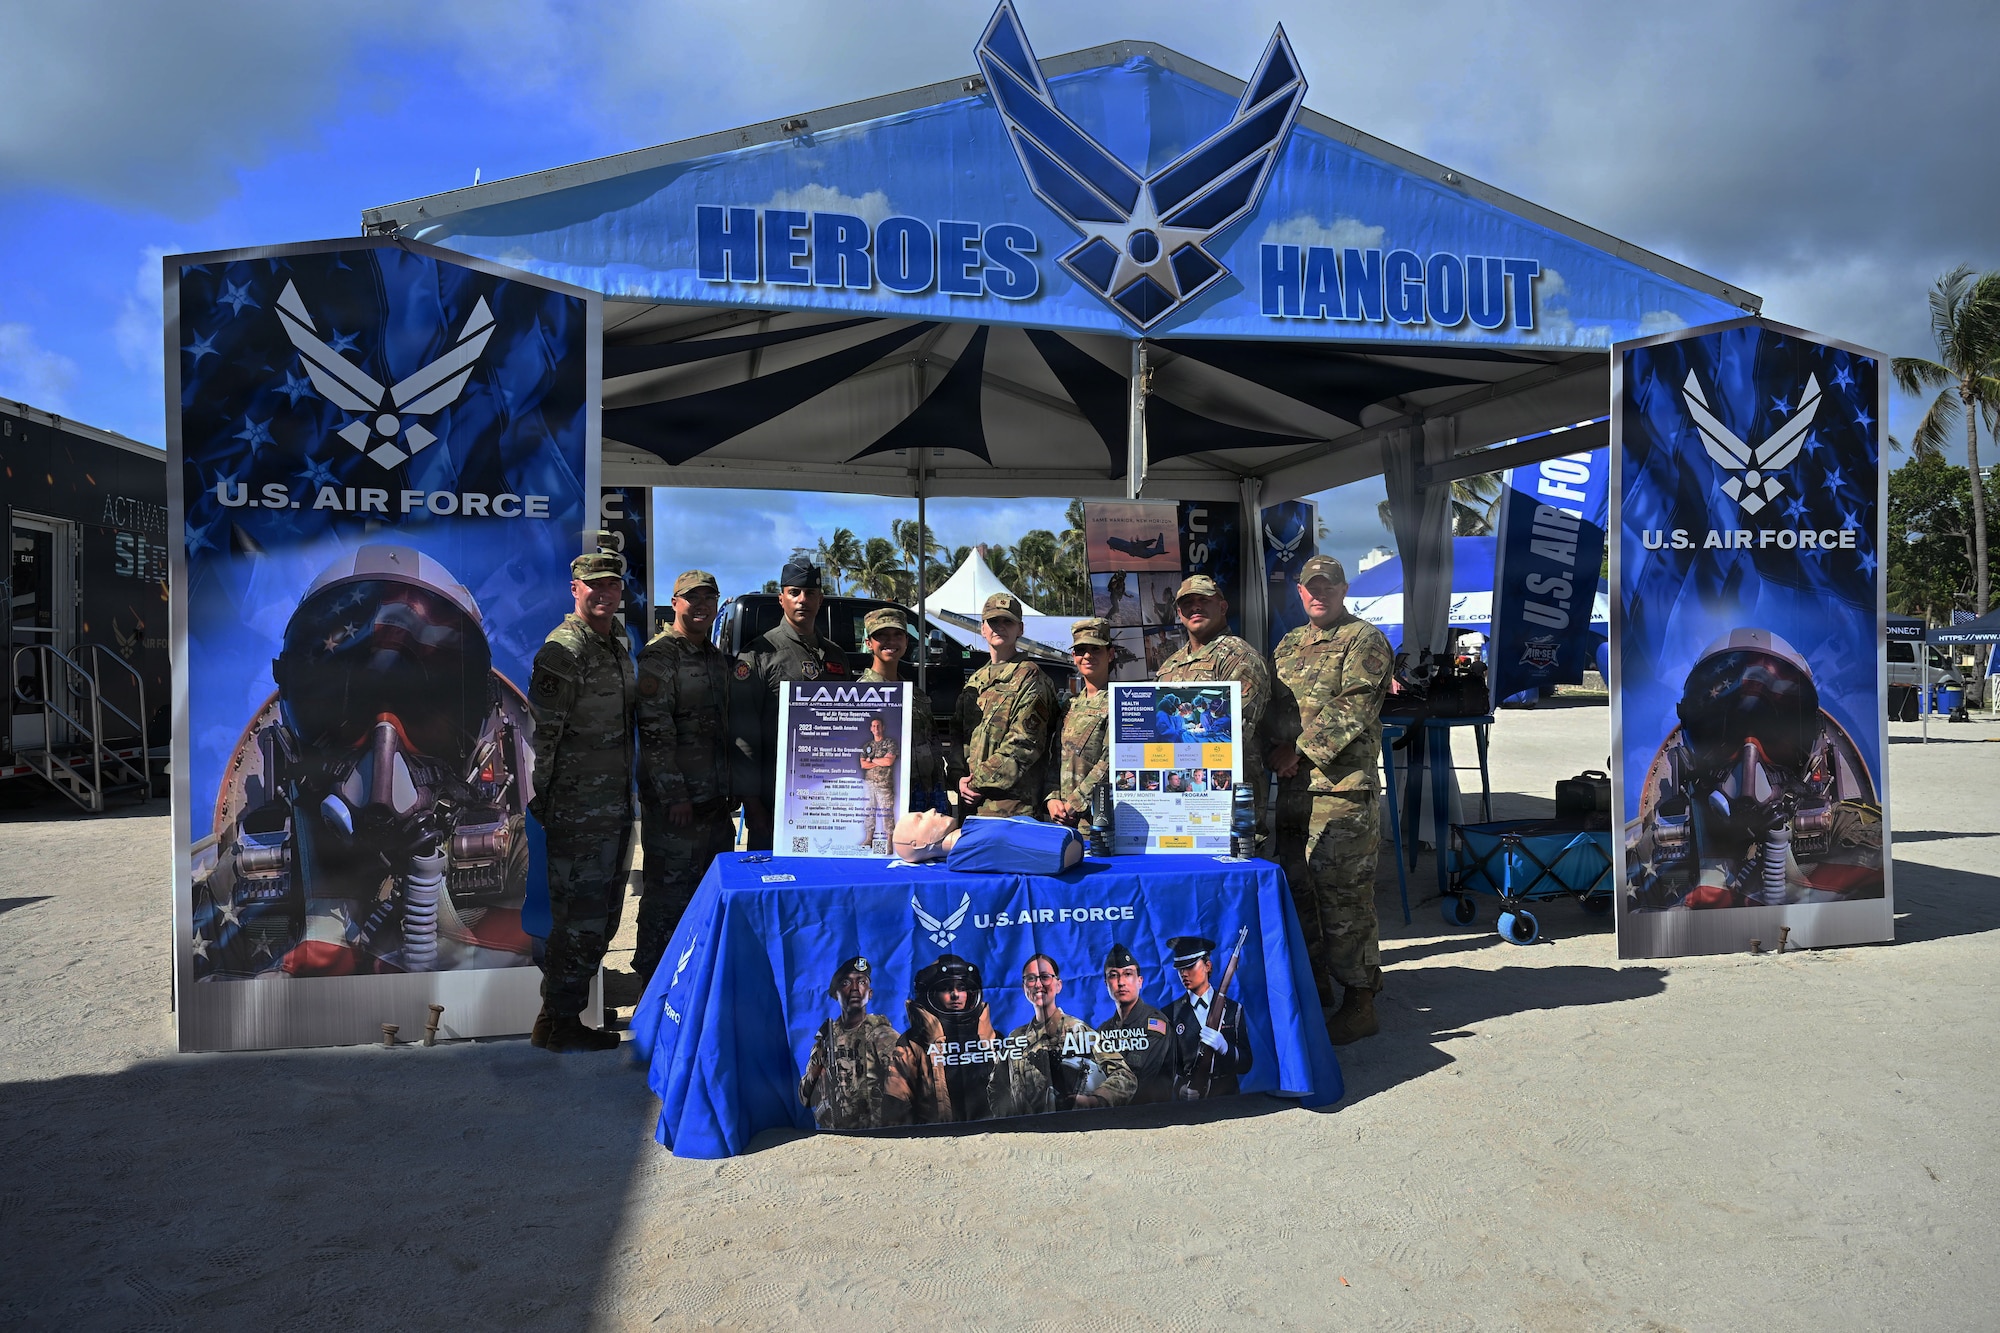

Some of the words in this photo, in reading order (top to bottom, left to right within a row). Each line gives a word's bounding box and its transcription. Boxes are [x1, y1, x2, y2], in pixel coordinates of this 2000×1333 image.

[695, 204, 1039, 300] HEROES
[1259, 243, 1540, 330] HANGOUT
[1537, 450, 1593, 502] FO
[216, 481, 300, 509] U.S.
[312, 486, 389, 513] AIR
[400, 490, 550, 519] FORCE
[103, 494, 168, 534] ACTIVAT
[1189, 509, 1208, 572] U.S.
[1530, 504, 1583, 566] AIR
[1642, 528, 1695, 549] U.S.
[1703, 529, 1753, 549] AIR
[1759, 528, 1856, 549] FORCE
[21, 555, 34, 563] EXIT
[1522, 571, 1574, 630] U.S.
[1886, 626, 1921, 635] ONNECT
[795, 686, 898, 702] LAMAT
[974, 912, 1014, 928] U.S.
[1018, 908, 1054, 925] AIR
[1060, 906, 1134, 923] FORCE
[664, 1001, 681, 1025] FORC
[926, 1041, 960, 1056] AIR
[964, 1035, 1028, 1052] FORCE
[1061, 1031, 1102, 1056] AIR
[1101, 1028, 1148, 1040] NATIONAL
[1102, 1038, 1150, 1053] GUARD
[933, 1048, 1024, 1067] RESERVE
